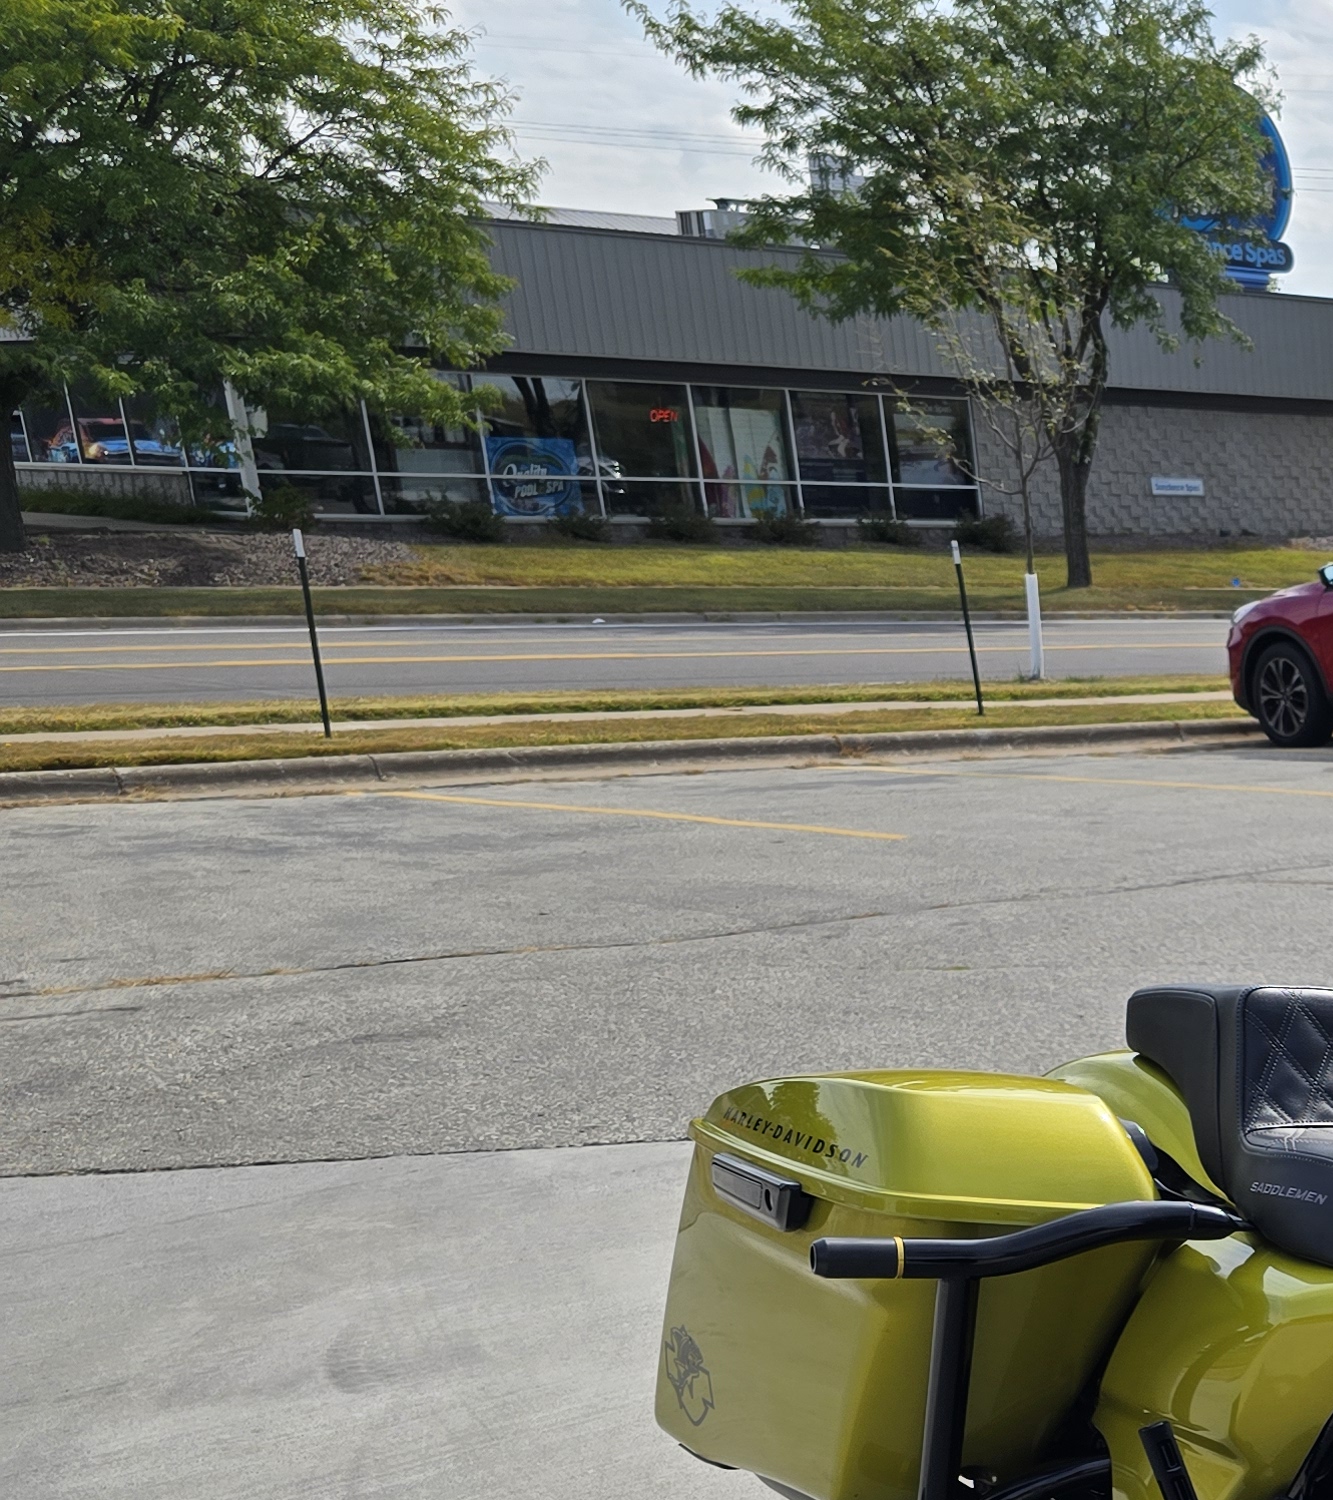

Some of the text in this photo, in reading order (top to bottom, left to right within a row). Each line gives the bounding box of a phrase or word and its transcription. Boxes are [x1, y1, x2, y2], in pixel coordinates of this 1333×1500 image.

[1246, 242, 1286, 268] Spas
[650, 409, 678, 422] OPEN
[514, 481, 564, 499] POOL SPA
[722, 1106, 869, 1169] HARLEY-DAVIDSON
[1249, 1181, 1328, 1205] SADDLEMEN
